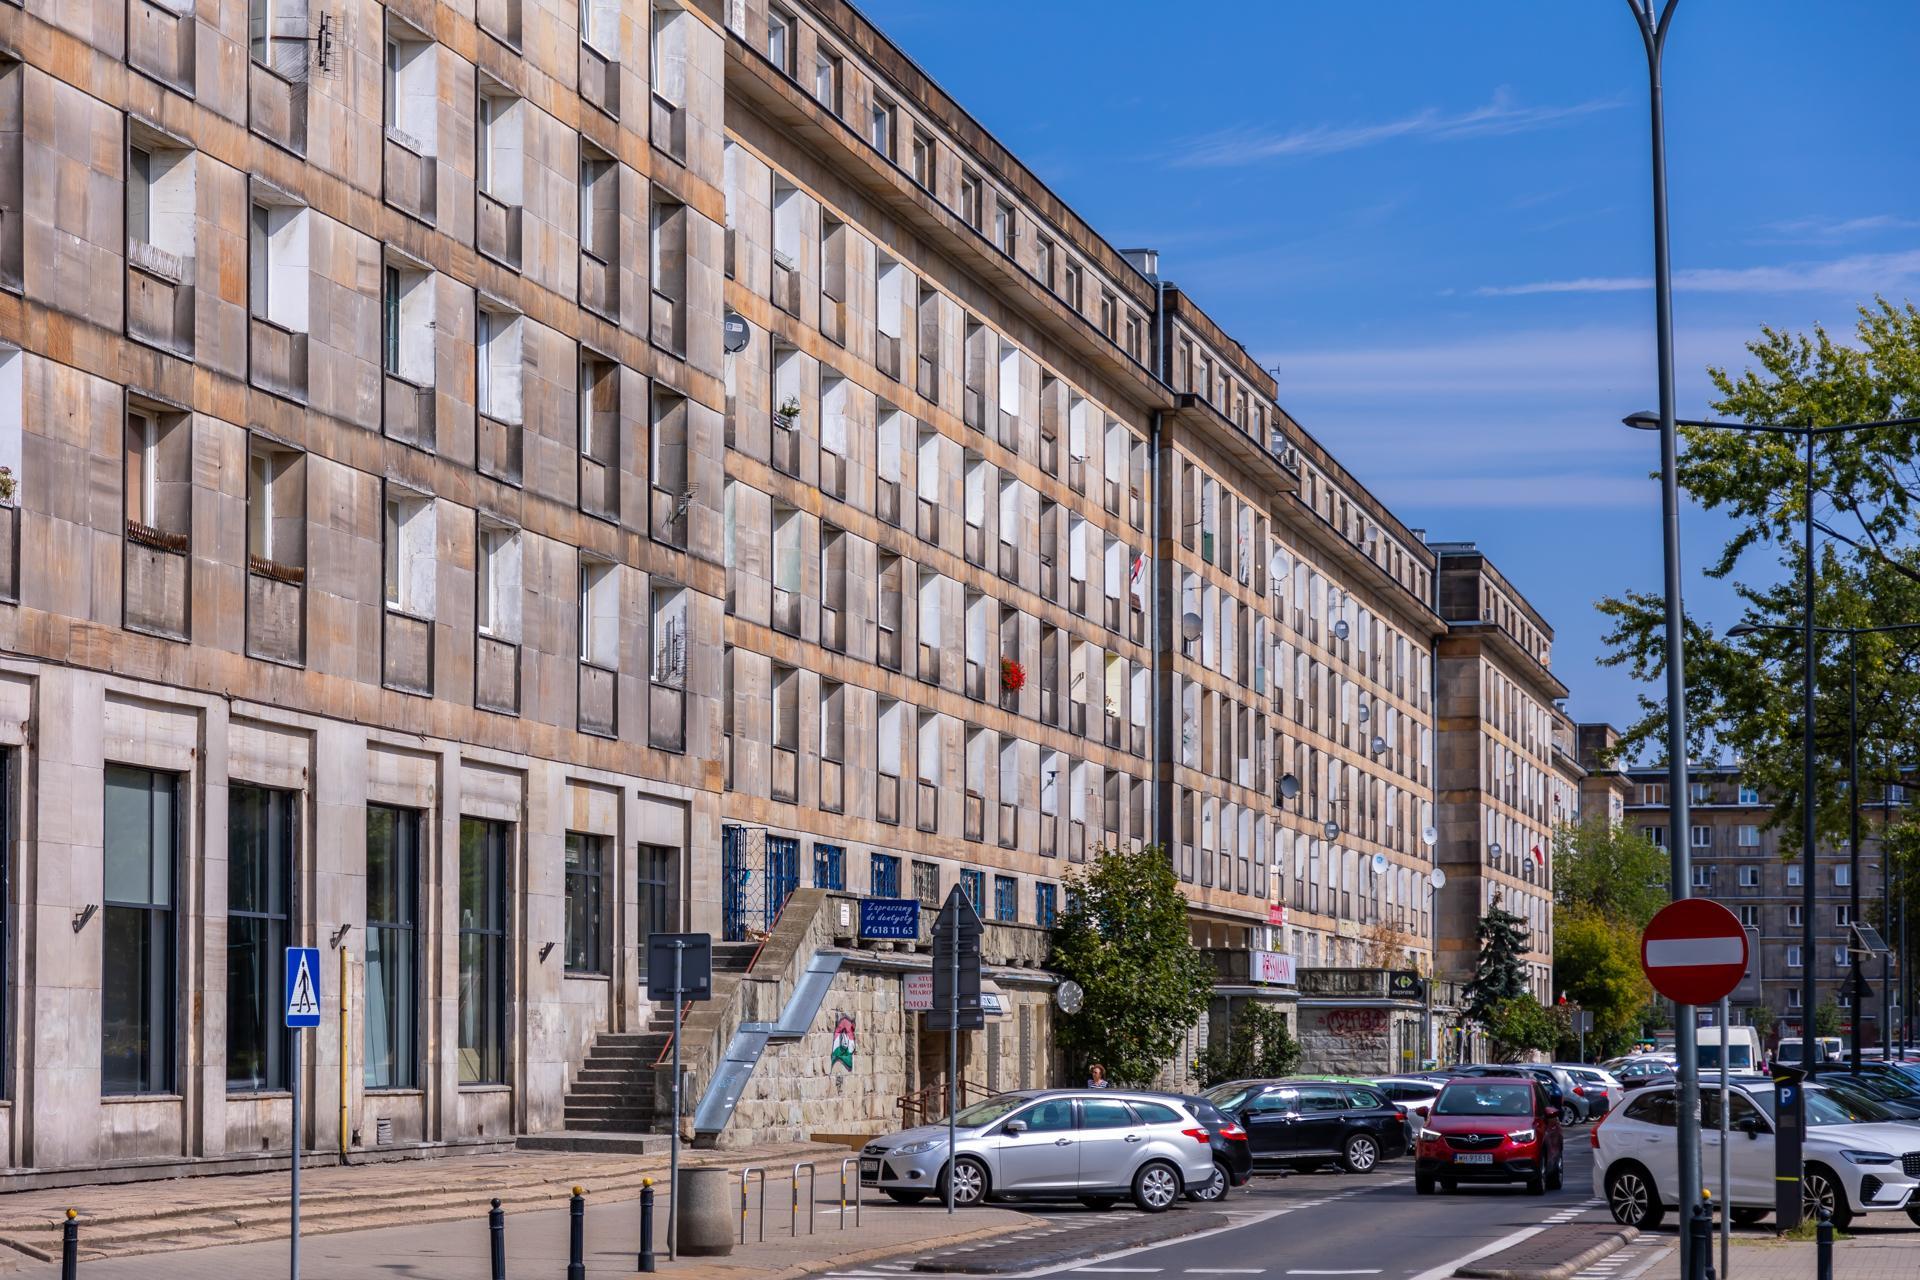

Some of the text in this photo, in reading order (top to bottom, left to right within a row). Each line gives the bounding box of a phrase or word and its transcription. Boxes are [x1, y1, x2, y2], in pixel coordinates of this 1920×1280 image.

[867, 902, 912, 915] Zapraszamy
[877, 913, 913, 924] dentysty
[872, 926, 914, 935] 618 11 65
[1781, 1088, 1792, 1104] P
